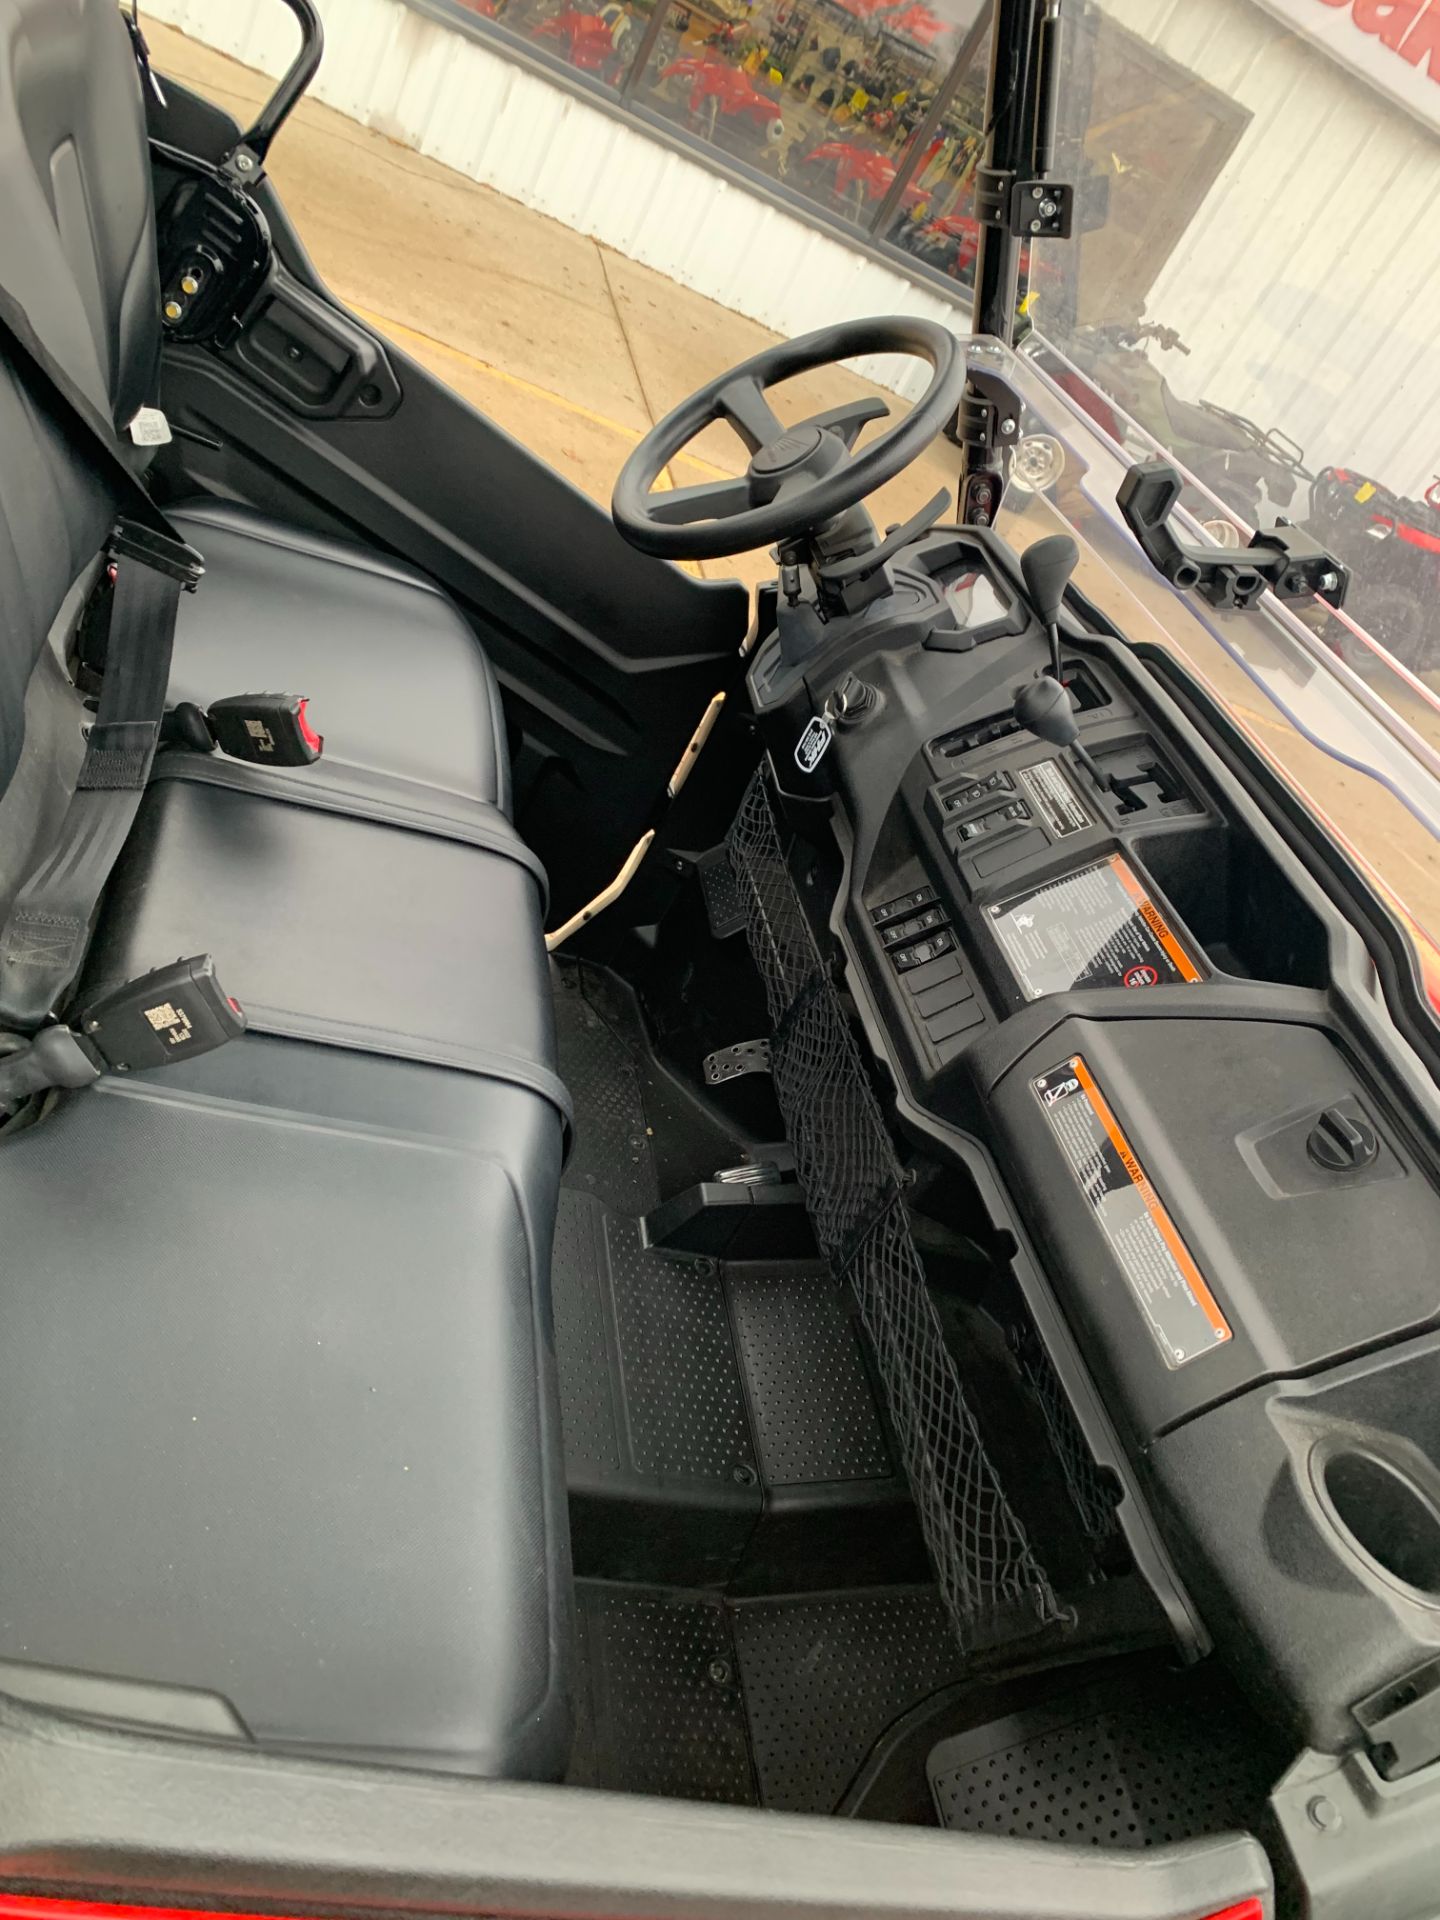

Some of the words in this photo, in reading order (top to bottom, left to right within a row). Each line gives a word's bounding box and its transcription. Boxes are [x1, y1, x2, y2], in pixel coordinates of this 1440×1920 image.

[1139, 899, 1168, 938] WARNING
[899, 953, 908, 962] OFF
[1125, 1157, 1159, 1210] WARNING
